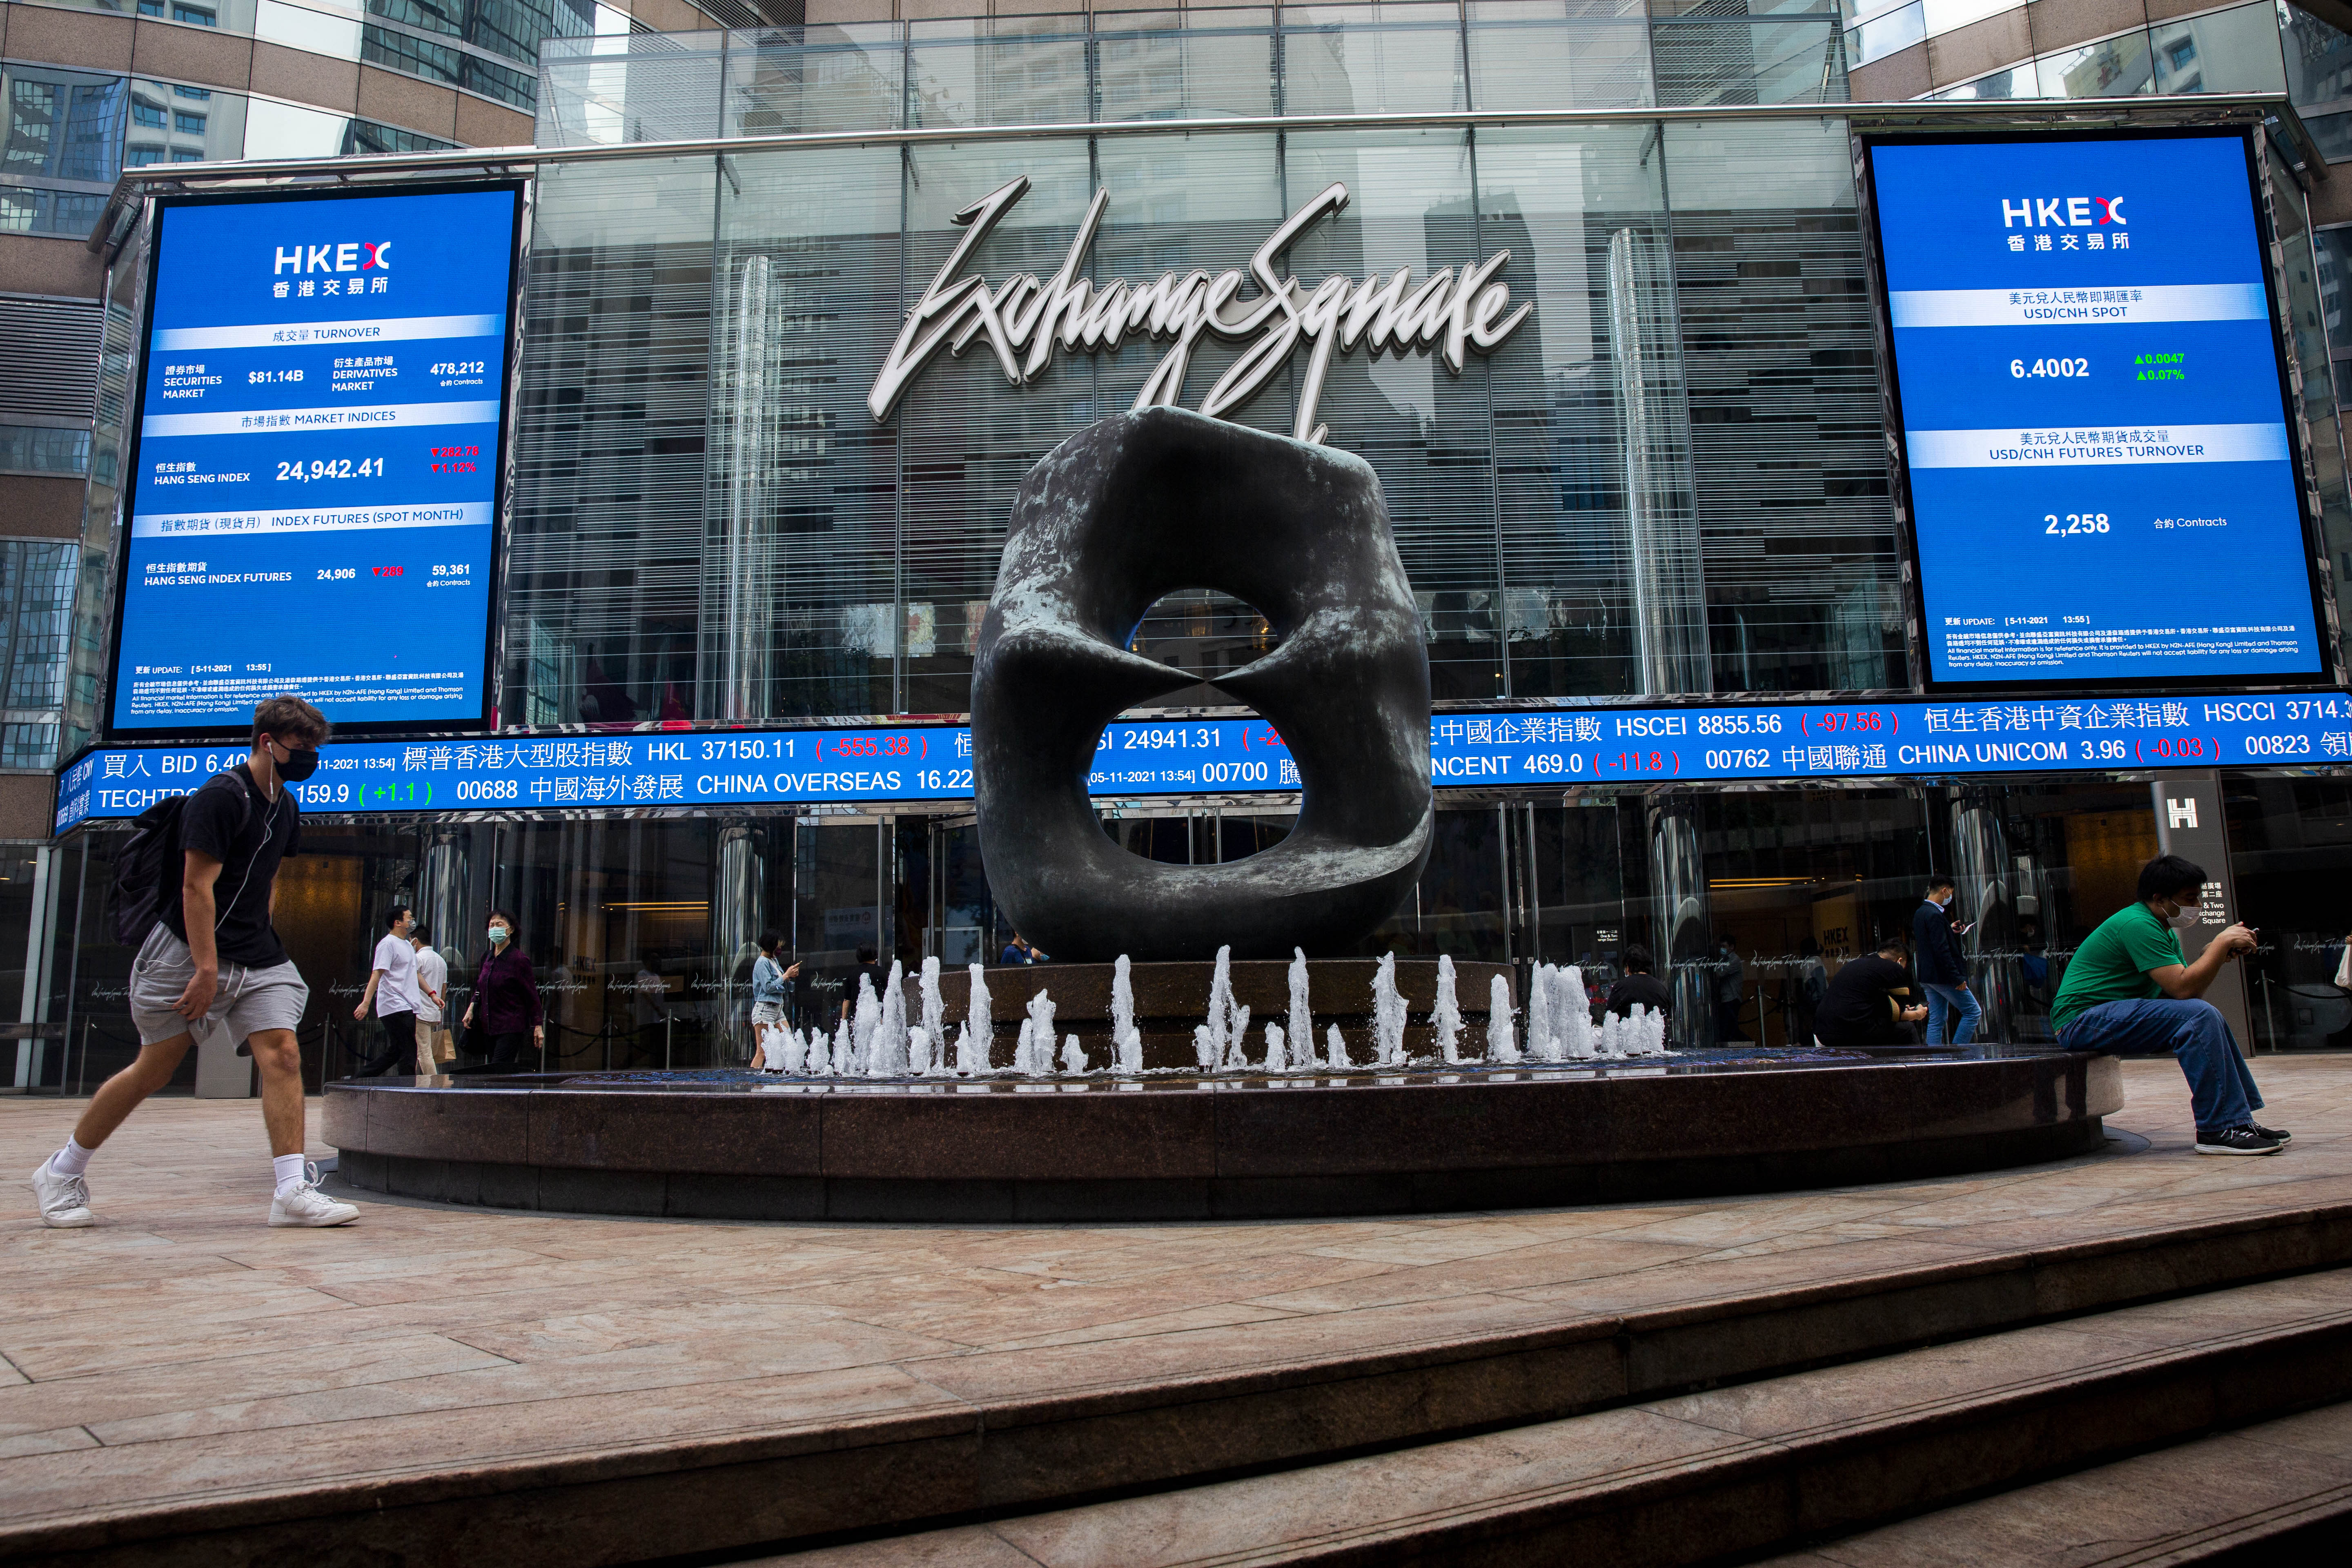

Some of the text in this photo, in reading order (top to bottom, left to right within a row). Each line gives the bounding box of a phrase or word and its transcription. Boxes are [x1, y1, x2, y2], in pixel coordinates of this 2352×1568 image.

[2002, 196, 2127, 228] HKEX
[2007, 233, 2129, 251] 香港交易所
[274, 242, 391, 275] HKEX
[273, 277, 388, 297] 香港交易所
[2009, 290, 2143, 305] 美元兌人民幣即期匯率
[867, 175, 1533, 445] Exchange Square
[2025, 307, 2127, 319] USD/CNH SPOT
[274, 327, 380, 341] 成交量 TURNOVER
[334, 356, 393, 368] 衍生產品市場
[2145, 354, 2184, 364] 0.0047
[165, 365, 205, 375] 證券市場
[333, 368, 397, 379] DERIVATIVES
[430, 361, 483, 376] 478,212
[2011, 358, 2089, 378] 6.4002
[2148, 369, 2184, 380] 0.07%
[164, 376, 222, 386] SECURITIES
[248, 370, 303, 384] $81.14B
[332, 381, 374, 391] MARKET
[163, 389, 205, 399] MARKET
[242, 412, 395, 427] 市場指數 MARKET INDICES
[2021, 430, 2169, 445] 美元兌人民幣期貨成交量
[441, 446, 479, 457] 282.78
[1990, 445, 2204, 460] USD/CNH FUTURES TURNOVER
[156, 462, 196, 473] 恒生指數
[276, 458, 383, 483] 24,942.41
[442, 462, 476, 473] 1.12%
[154, 473, 250, 484] HANG SENG INDEX
[161, 519, 210, 532] 指數期貨
[272, 516, 309, 526] INDEX
[314, 514, 369, 524] FUTURES
[373, 512, 409, 523] (SPOT
[413, 508, 463, 521] MONTH)
[2045, 514, 2109, 537] 2,258
[2154, 517, 2227, 528] 合約 Contracts
[146, 562, 207, 573] 恒生指數期貨
[317, 568, 355, 581] 24,906
[382, 566, 403, 577] 289
[432, 564, 469, 577] 59,361
[145, 572, 291, 586] HANG SENG INDEX FUTURES
[1617, 717, 1686, 736] HSCEI
[1699, 715, 1782, 734] 8855.56
[1924, 701, 2189, 734] 恒生香港中資企業指數
[2204, 702, 2275, 721] HSCCI
[1124, 728, 1219, 748] 24941.31
[1258, 727, 1287, 746] -2
[102, 755, 151, 779] 買入
[162, 755, 196, 773] BID
[363, 758, 395, 771] 13:54]
[401, 741, 633, 772] 標普香港大型股指數
[648, 741, 692, 762] HKL
[702, 739, 793, 760] 37150.11
[1431, 755, 1512, 777] NCENT
[1524, 754, 1582, 773] 469.0
[1706, 749, 1771, 768] 00762
[1782, 744, 1887, 771] 中國聯通
[1899, 745, 1971, 764] CHINA
[1976, 741, 2068, 763] UNICOM
[2081, 740, 2126, 759] 3.96
[2245, 735, 2310, 755] 00823
[83, 758, 94, 780] CNY
[1160, 770, 1195, 783] 13:54]
[1203, 762, 1267, 782] 00700
[295, 783, 350, 804] 159.9
[457, 780, 517, 800] 00688
[530, 774, 683, 802] 中國海外發展
[697, 775, 768, 794] CHINA
[774, 771, 901, 792] OVERSEAS
[916, 768, 973, 789] 16.22
[56, 805, 68, 827] 00669
[1823, 927, 1849, 945] HKEX
[573, 955, 596, 972] HKEX
